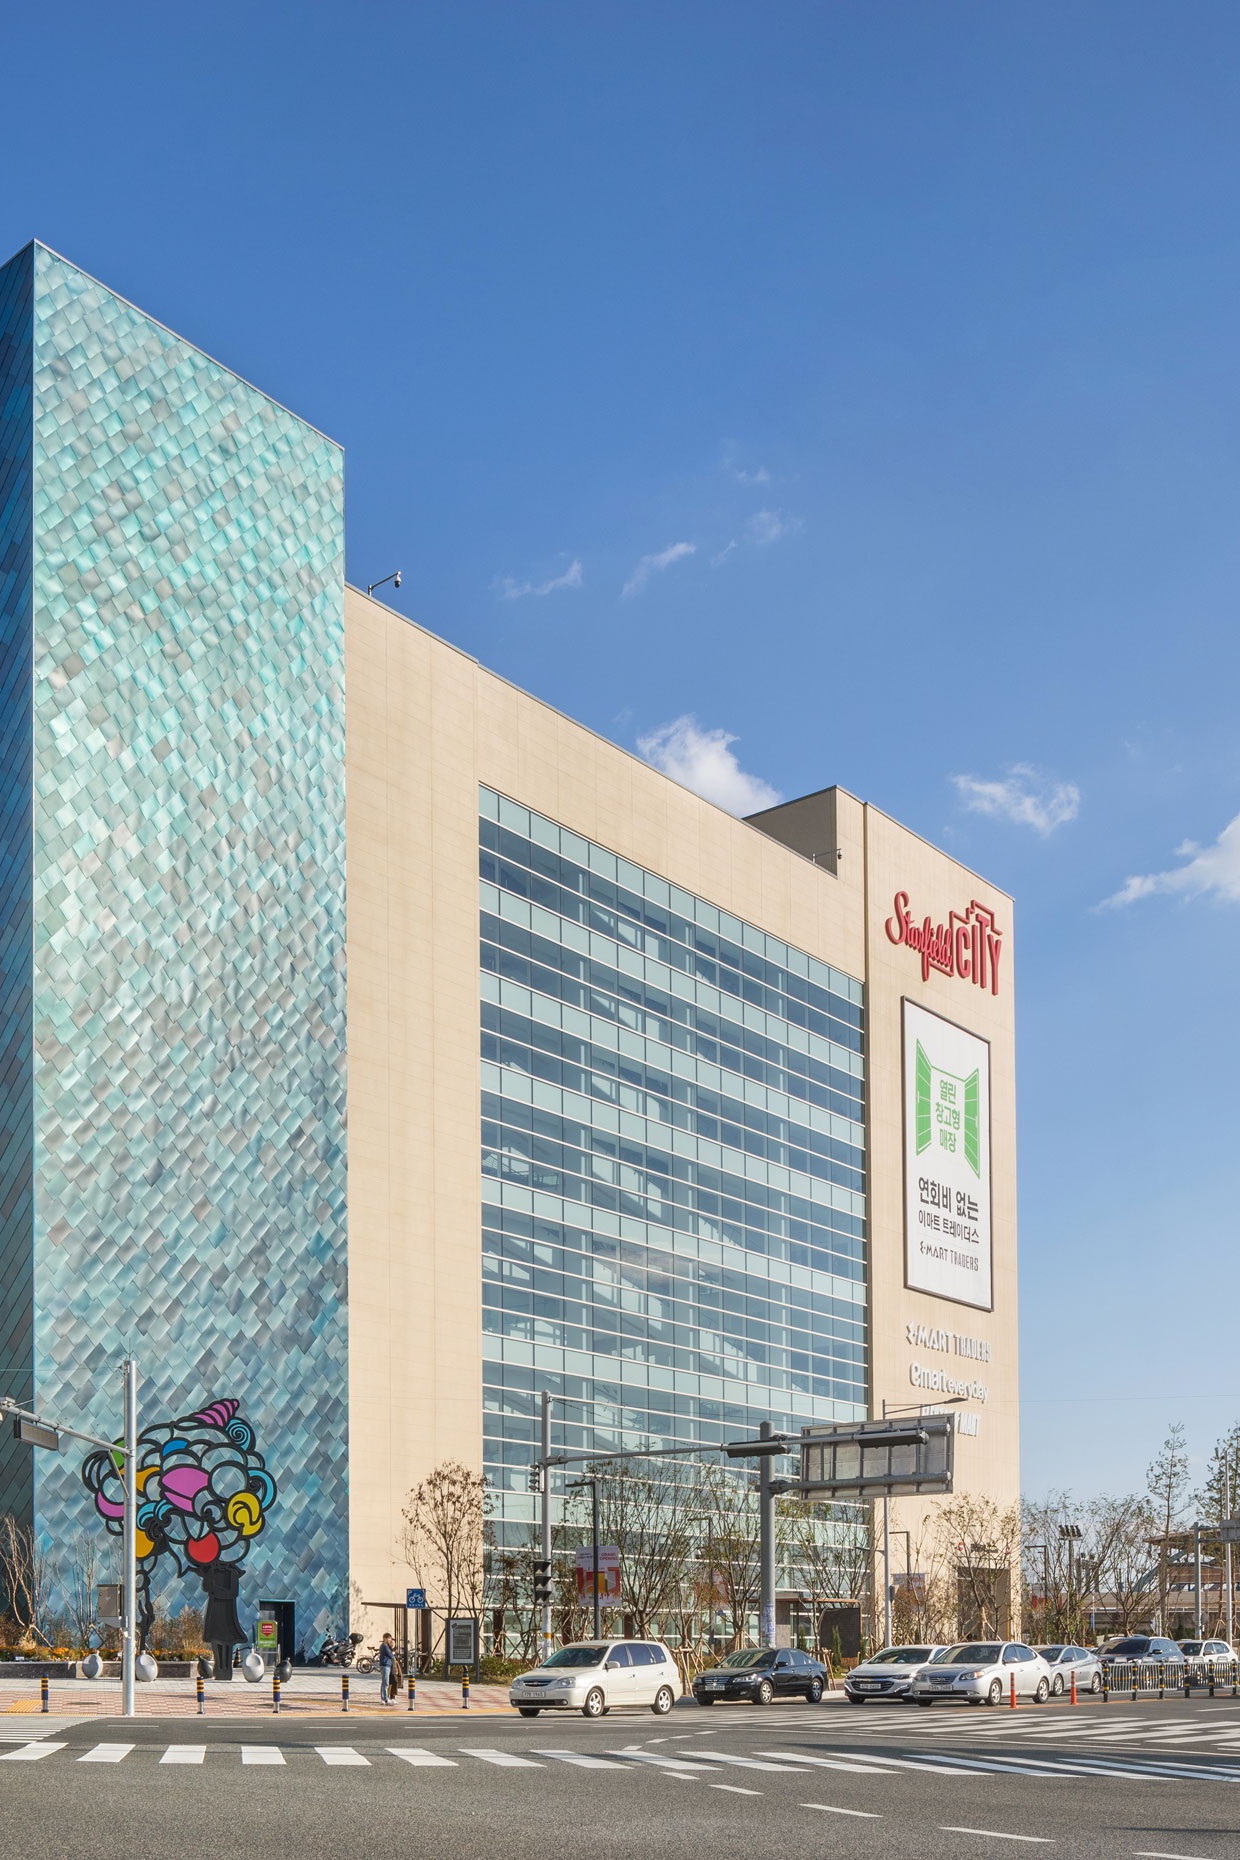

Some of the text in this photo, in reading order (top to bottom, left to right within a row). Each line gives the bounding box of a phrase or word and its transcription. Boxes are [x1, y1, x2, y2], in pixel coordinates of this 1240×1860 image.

[885, 890, 1002, 996] Starfield CITY
[940, 1079, 957, 1105] 열린
[935, 1101, 961, 1131] 창고형
[939, 1128, 957, 1153] 매장
[918, 1177, 979, 1222] 연회비 없는
[918, 1209, 980, 1244] 이마트 트레이더스
[950, 1249, 979, 1272] TRADERS
[953, 1334, 992, 1363] TRADERS
[947, 1378, 989, 1404] everyday
